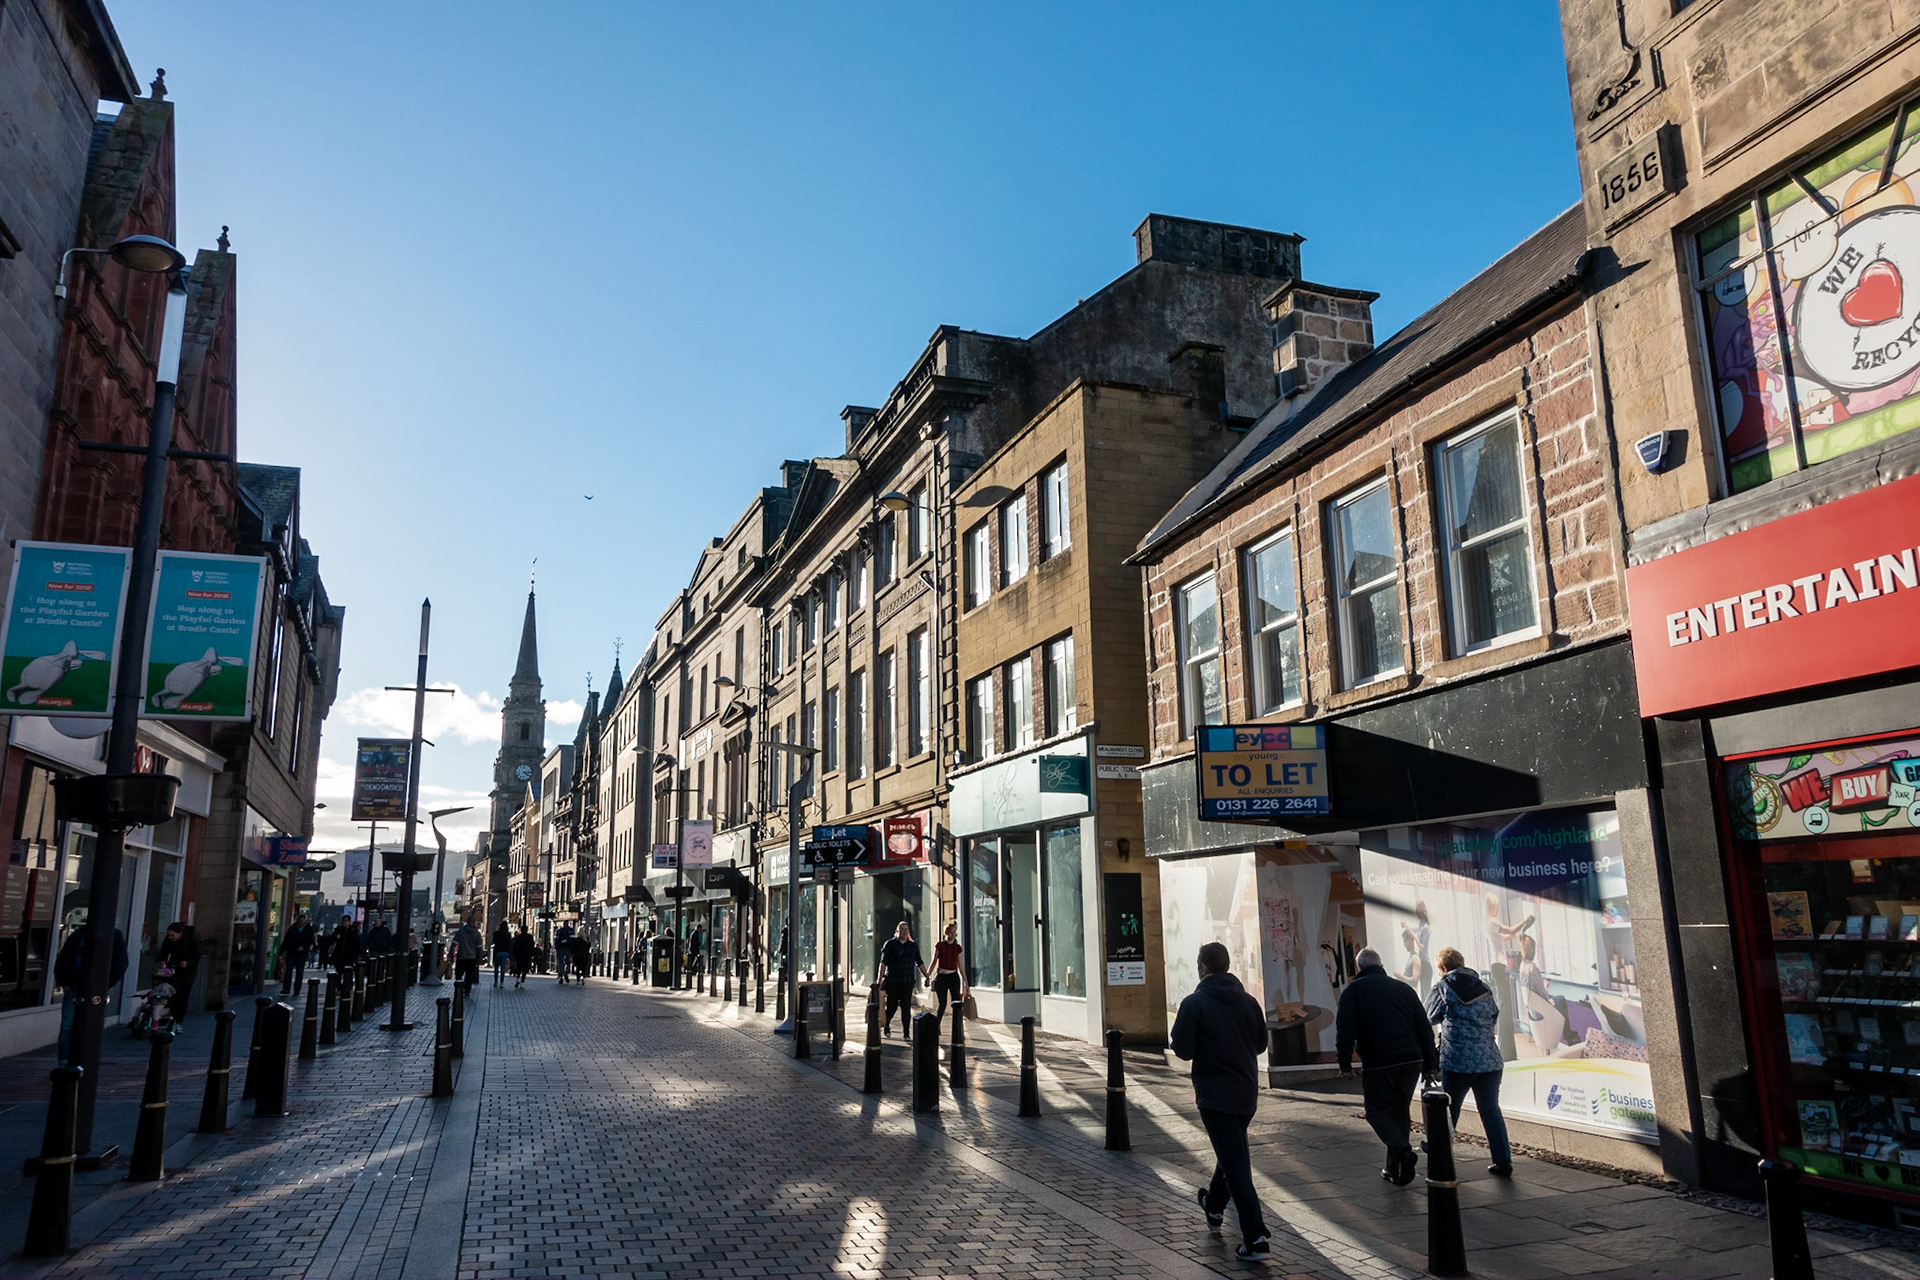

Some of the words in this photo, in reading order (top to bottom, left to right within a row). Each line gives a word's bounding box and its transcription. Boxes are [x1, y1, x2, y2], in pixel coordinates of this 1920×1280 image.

[1602, 151, 1658, 210] 1856
[1818, 244, 1865, 295] WE
[36, 597, 56, 606] Hop
[58, 598, 84, 608] along
[1666, 546, 1920, 647] ENTERTAIN
[39, 607, 72, 616] Playful
[178, 605, 196, 613] Hop
[198, 607, 222, 615] along
[180, 615, 211, 624] Playful
[178, 625, 208, 633] Brodie
[210, 626, 239, 634] Castle!
[1235, 732, 1290, 746] eyco
[1248, 752, 1278, 761] young
[1211, 764, 1252, 787] TO
[1265, 762, 1318, 786] LET
[1238, 787, 1251, 795] ALL
[1254, 787, 1294, 795] ENQUIRIES
[1782, 771, 1826, 811] WE
[1840, 775, 1878, 800] BUY
[1894, 789, 1911, 800] YOUR
[1216, 800, 1247, 810] 0131
[1252, 800, 1279, 810] 226
[1285, 798, 1317, 809] 2641
[1740, 784, 1770, 814] MONTHS
[280, 840, 305, 850] Shoe
[279, 852, 303, 863] Zone
[776, 851, 790, 865] MOUN
[1368, 872, 1387, 886] Can
[1388, 874, 1407, 886] you
[1409, 870, 1450, 885] imagine
[1452, 869, 1478, 884] your
[1482, 867, 1505, 879] new
[1508, 860, 1567, 877] business
[1571, 856, 1611, 874] here?
[1842, 1158, 1865, 1179] WE
